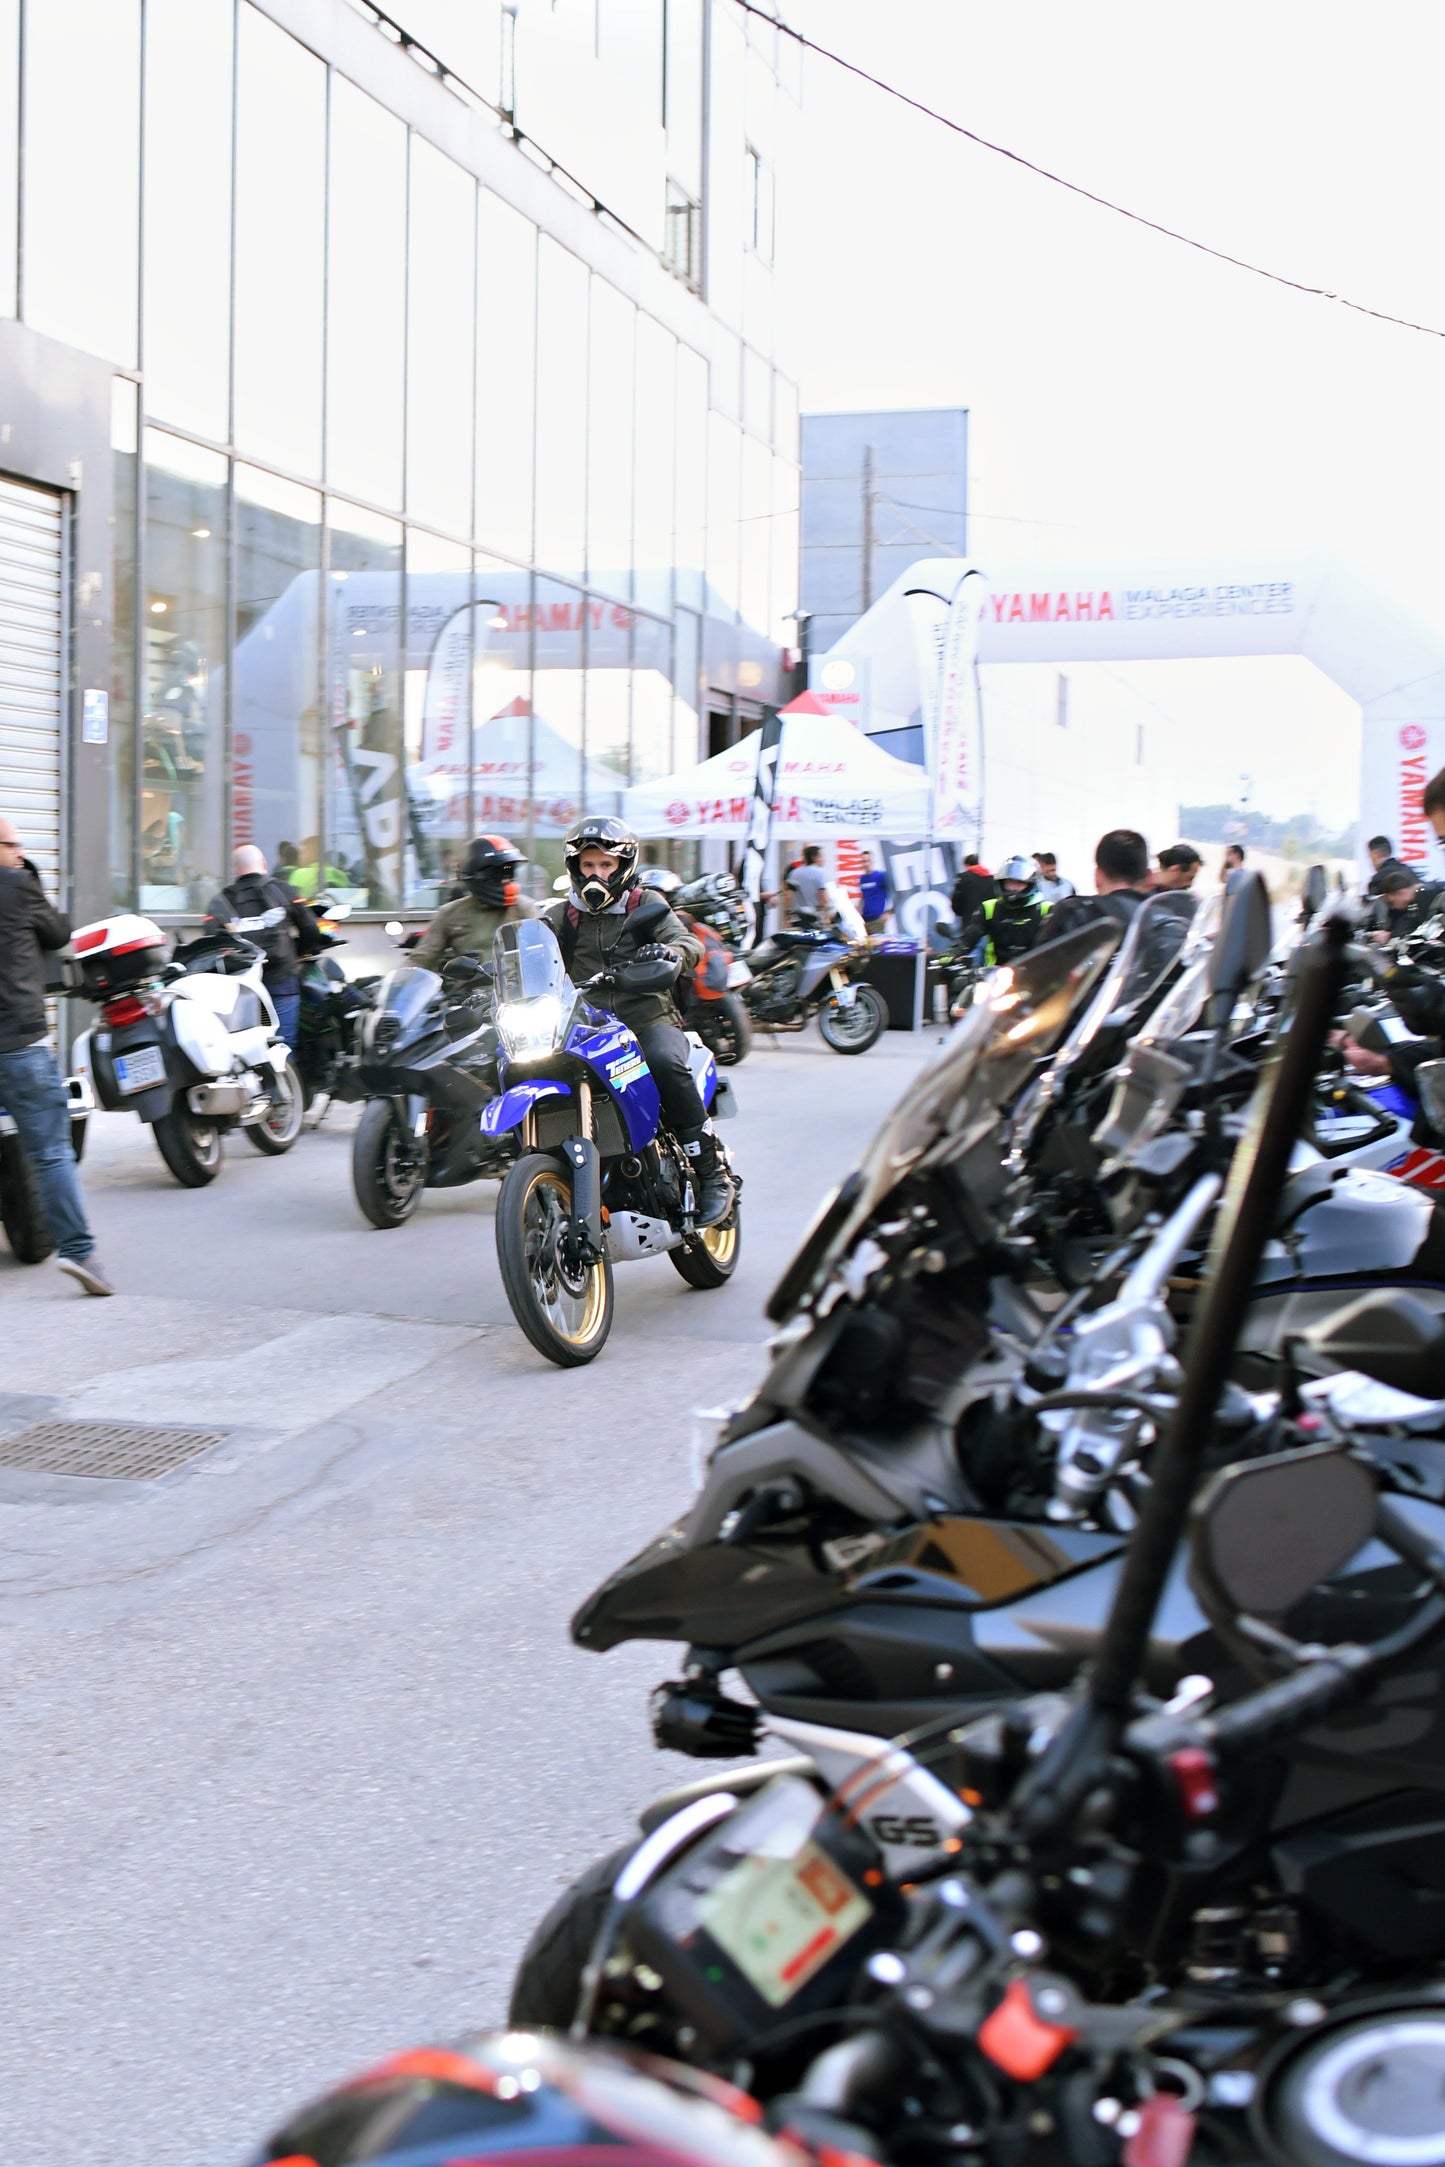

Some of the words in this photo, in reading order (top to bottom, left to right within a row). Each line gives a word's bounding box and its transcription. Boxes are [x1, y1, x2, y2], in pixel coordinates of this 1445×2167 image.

[1215, 582, 1293, 599] CENTER
[990, 590, 1115, 622] YAMAHA
[697, 796, 803, 824] YAMHA
[812, 811, 882, 824] CENTER
[1399, 755, 1428, 863] YAMAHA
[870, 1815, 940, 1847] GS
